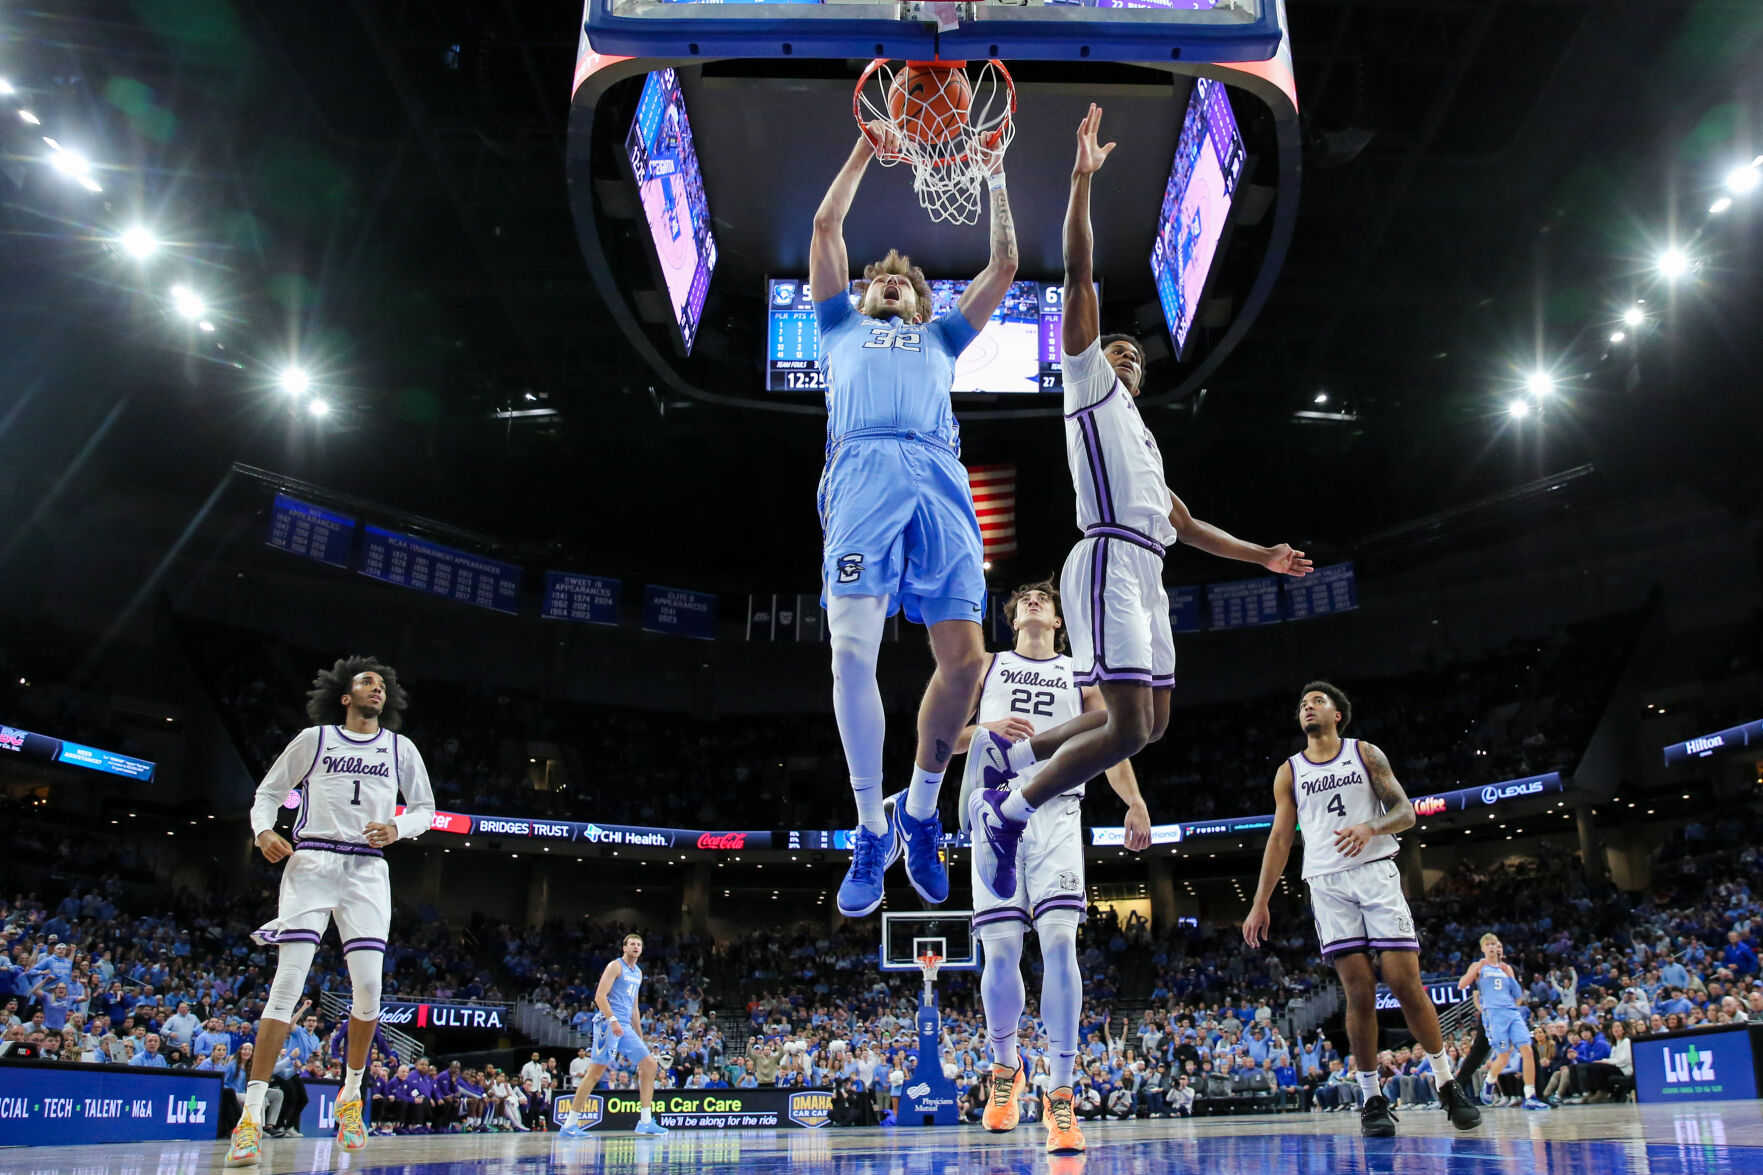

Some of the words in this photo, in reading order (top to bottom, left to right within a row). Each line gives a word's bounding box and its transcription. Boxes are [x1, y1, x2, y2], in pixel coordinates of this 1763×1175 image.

[862, 328, 921, 353] 32
[776, 361, 792, 369] TEAM
[792, 360, 808, 369] FOULS
[1043, 377, 1055, 387] 27
[554, 584, 612, 598] APPEARANCES
[564, 576, 591, 587] SWEET
[1001, 669, 1069, 690] Wildcats
[1010, 688, 1055, 717] 22
[1686, 736, 1724, 755] Hilton
[322, 756, 390, 777] Wildcats
[351, 780, 361, 806] 1
[1301, 771, 1363, 796] Wildcats
[1498, 781, 1544, 800] LEXUS
[1327, 793, 1347, 817] 4
[1414, 796, 1446, 816] Coffee
[479, 820, 530, 835] BRIDGES
[600, 830, 622, 843] CHI
[1196, 826, 1226, 834] FUSION
[1494, 978, 1503, 991] 9
[1431, 985, 1471, 1005] ULT
[432, 1007, 501, 1028] ULTRA
[1663, 1044, 1715, 1083] Lutz
[43, 1097, 73, 1118] TECH
[85, 1098, 124, 1118] TALENT
[131, 1099, 152, 1118] M&A
[167, 1094, 207, 1124] Lutz
[319, 1094, 336, 1128] Lu
[670, 1097, 700, 1113] Car
[703, 1096, 742, 1113] Care
[793, 1095, 834, 1110] OMAHA
[914, 1104, 938, 1112] Mutual
[922, 1096, 954, 1107] Physicians
[660, 1116, 685, 1127] We'll
[685, 1116, 697, 1126] be
[699, 1116, 726, 1128] along
[727, 1115, 742, 1126] for
[742, 1115, 758, 1126] the
[759, 1115, 778, 1125] ride
[793, 1110, 810, 1118] CAR
